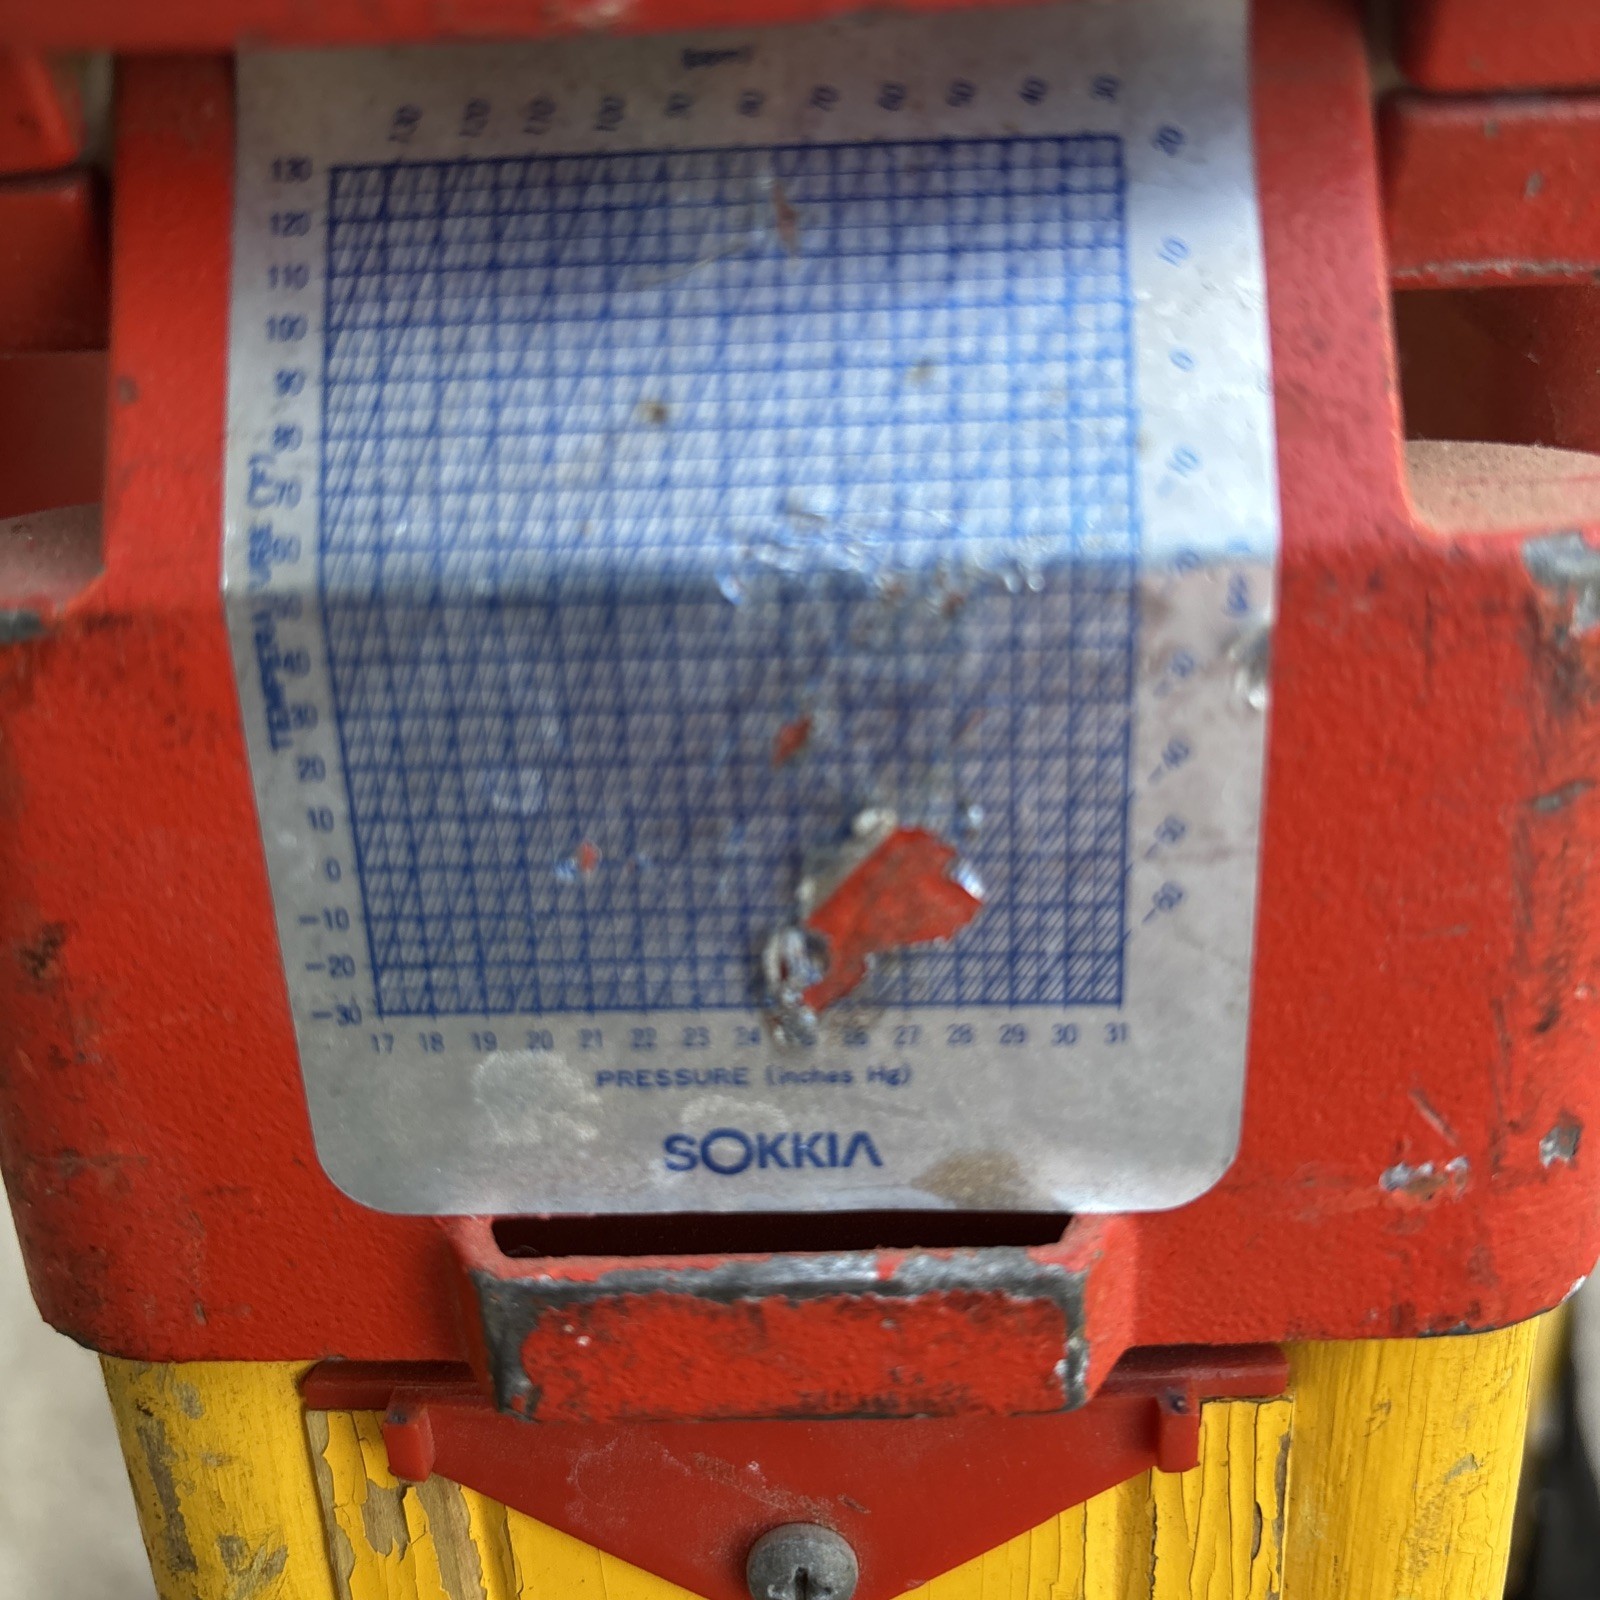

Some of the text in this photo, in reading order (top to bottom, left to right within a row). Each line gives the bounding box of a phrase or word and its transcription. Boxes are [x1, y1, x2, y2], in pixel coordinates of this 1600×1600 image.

[272, 156, 314, 184] 130
[269, 210, 312, 237] 120
[1158, 236, 1191, 268] 10
[267, 264, 310, 291] 110
[264, 315, 309, 343] 100
[1168, 349, 1194, 371] 0
[299, 756, 326, 782] 20
[306, 807, 335, 832] 10
[324, 858, 342, 882] 0
[298, 907, 350, 930] -10
[305, 956, 356, 979] -20
[311, 1002, 363, 1026] -30
[371, 1033, 394, 1053] 17
[420, 1032, 445, 1053] 18
[471, 1031, 498, 1052] 19
[526, 1029, 554, 1050] 20
[578, 1029, 602, 1049] 21
[630, 1028, 657, 1049] 22
[682, 1027, 709, 1048] 23
[894, 1024, 921, 1046] 27
[948, 1024, 974, 1045] 28
[1000, 1024, 1026, 1045] 29
[1051, 1024, 1079, 1045] 30
[1104, 1023, 1128, 1044] 31
[595, 1065, 912, 1088] PRESSURE (inches Hg)
[663, 1126, 883, 1175] SOKKIA
